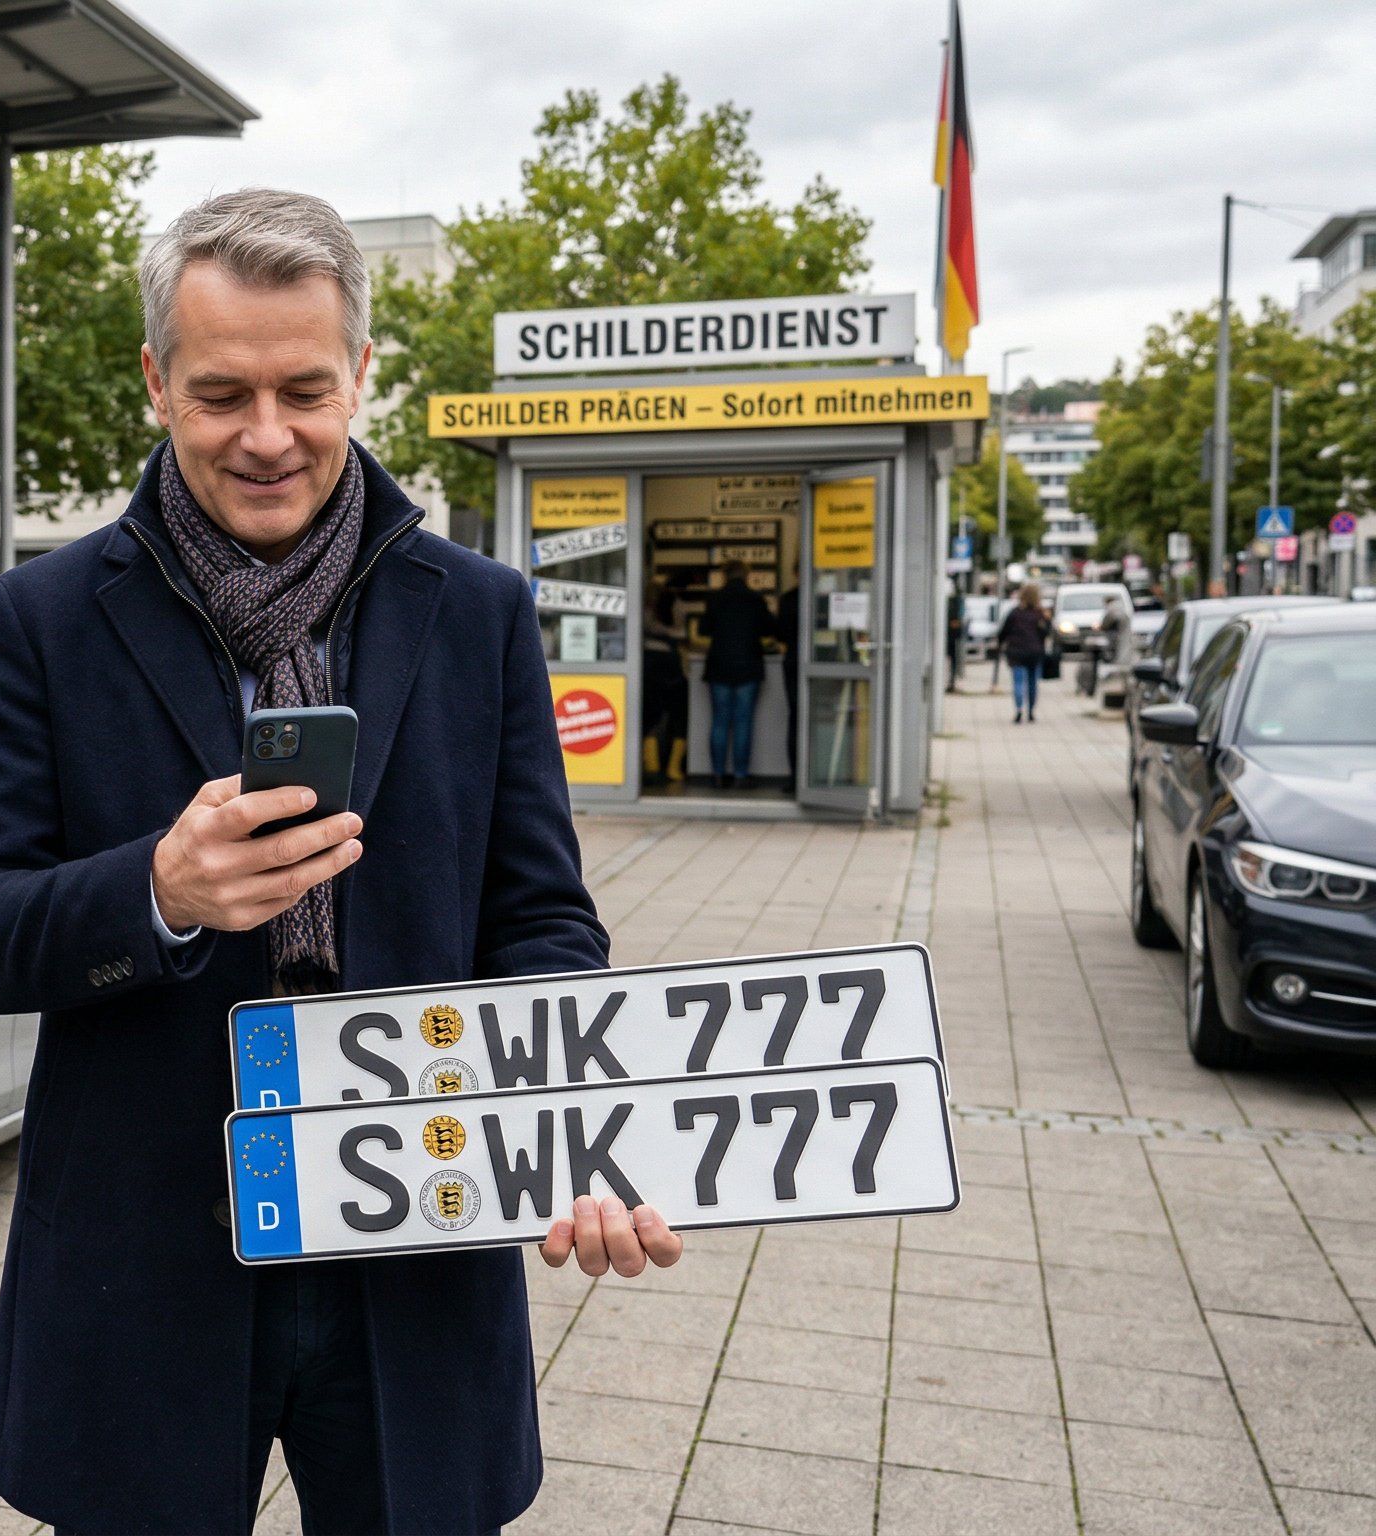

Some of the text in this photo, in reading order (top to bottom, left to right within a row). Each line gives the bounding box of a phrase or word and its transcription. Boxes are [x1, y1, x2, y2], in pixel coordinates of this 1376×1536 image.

[518, 305, 889, 361] SCHILDERDIENST
[443, 398, 570, 428] SCHILDER
[580, 390, 687, 423] PRÄGEN
[722, 391, 804, 418] Sofort
[815, 386, 973, 414] mitnehmen
[590, 590, 624, 611] 777
[339, 1012, 409, 1102] S
[478, 990, 629, 1090] WK
[665, 968, 887, 1073] 777
[257, 1201, 280, 1231] D
[339, 1123, 410, 1233] S
[481, 1102, 645, 1221] WK
[673, 1082, 899, 1206] 777
